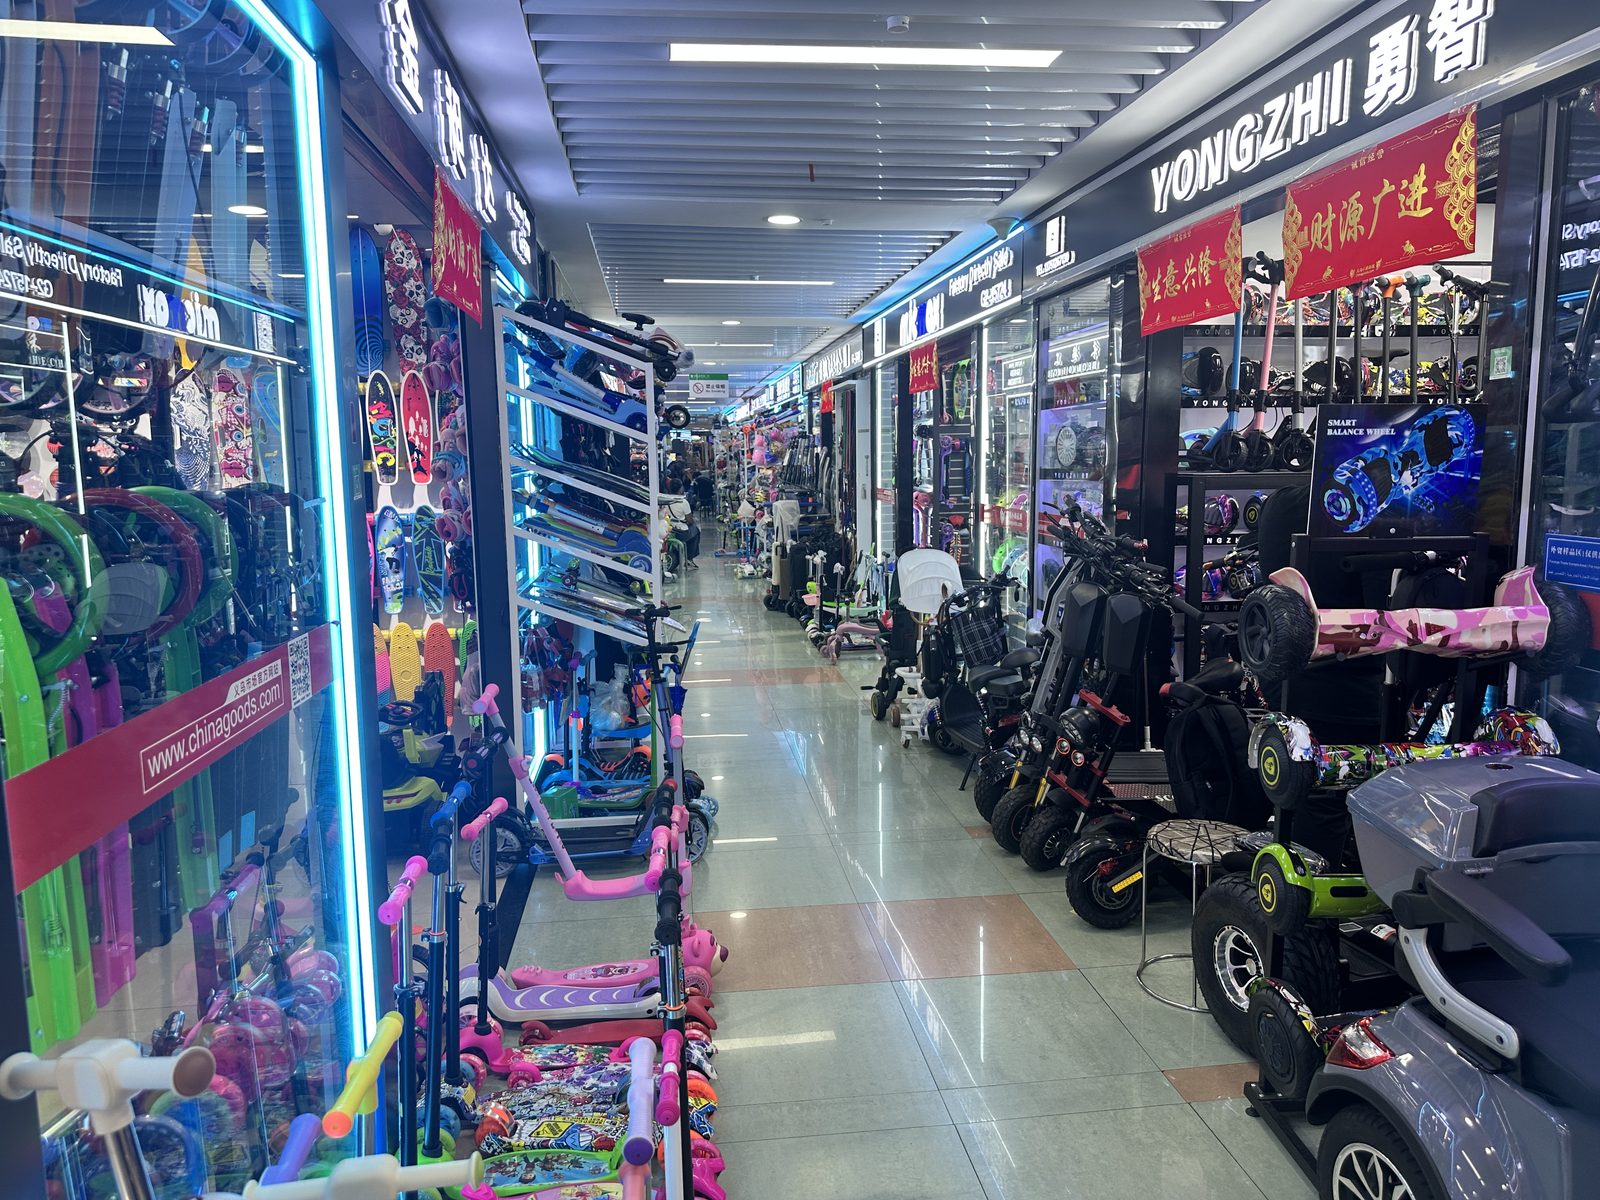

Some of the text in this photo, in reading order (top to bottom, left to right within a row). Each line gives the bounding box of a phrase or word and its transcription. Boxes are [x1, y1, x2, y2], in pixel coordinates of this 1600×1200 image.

[1150, 0, 1496, 213] YONGZHI 勇智
[1310, 162, 1434, 254] 财源广进
[1151, 245, 1218, 304] 生意兴隆
[1327, 419, 1357, 427] SMART
[1327, 428, 1396, 436] BALANCE WHEEL
[233, 662, 281, 698] 义乌市场官方网站
[147, 682, 281, 778] www.chinagoods.com
